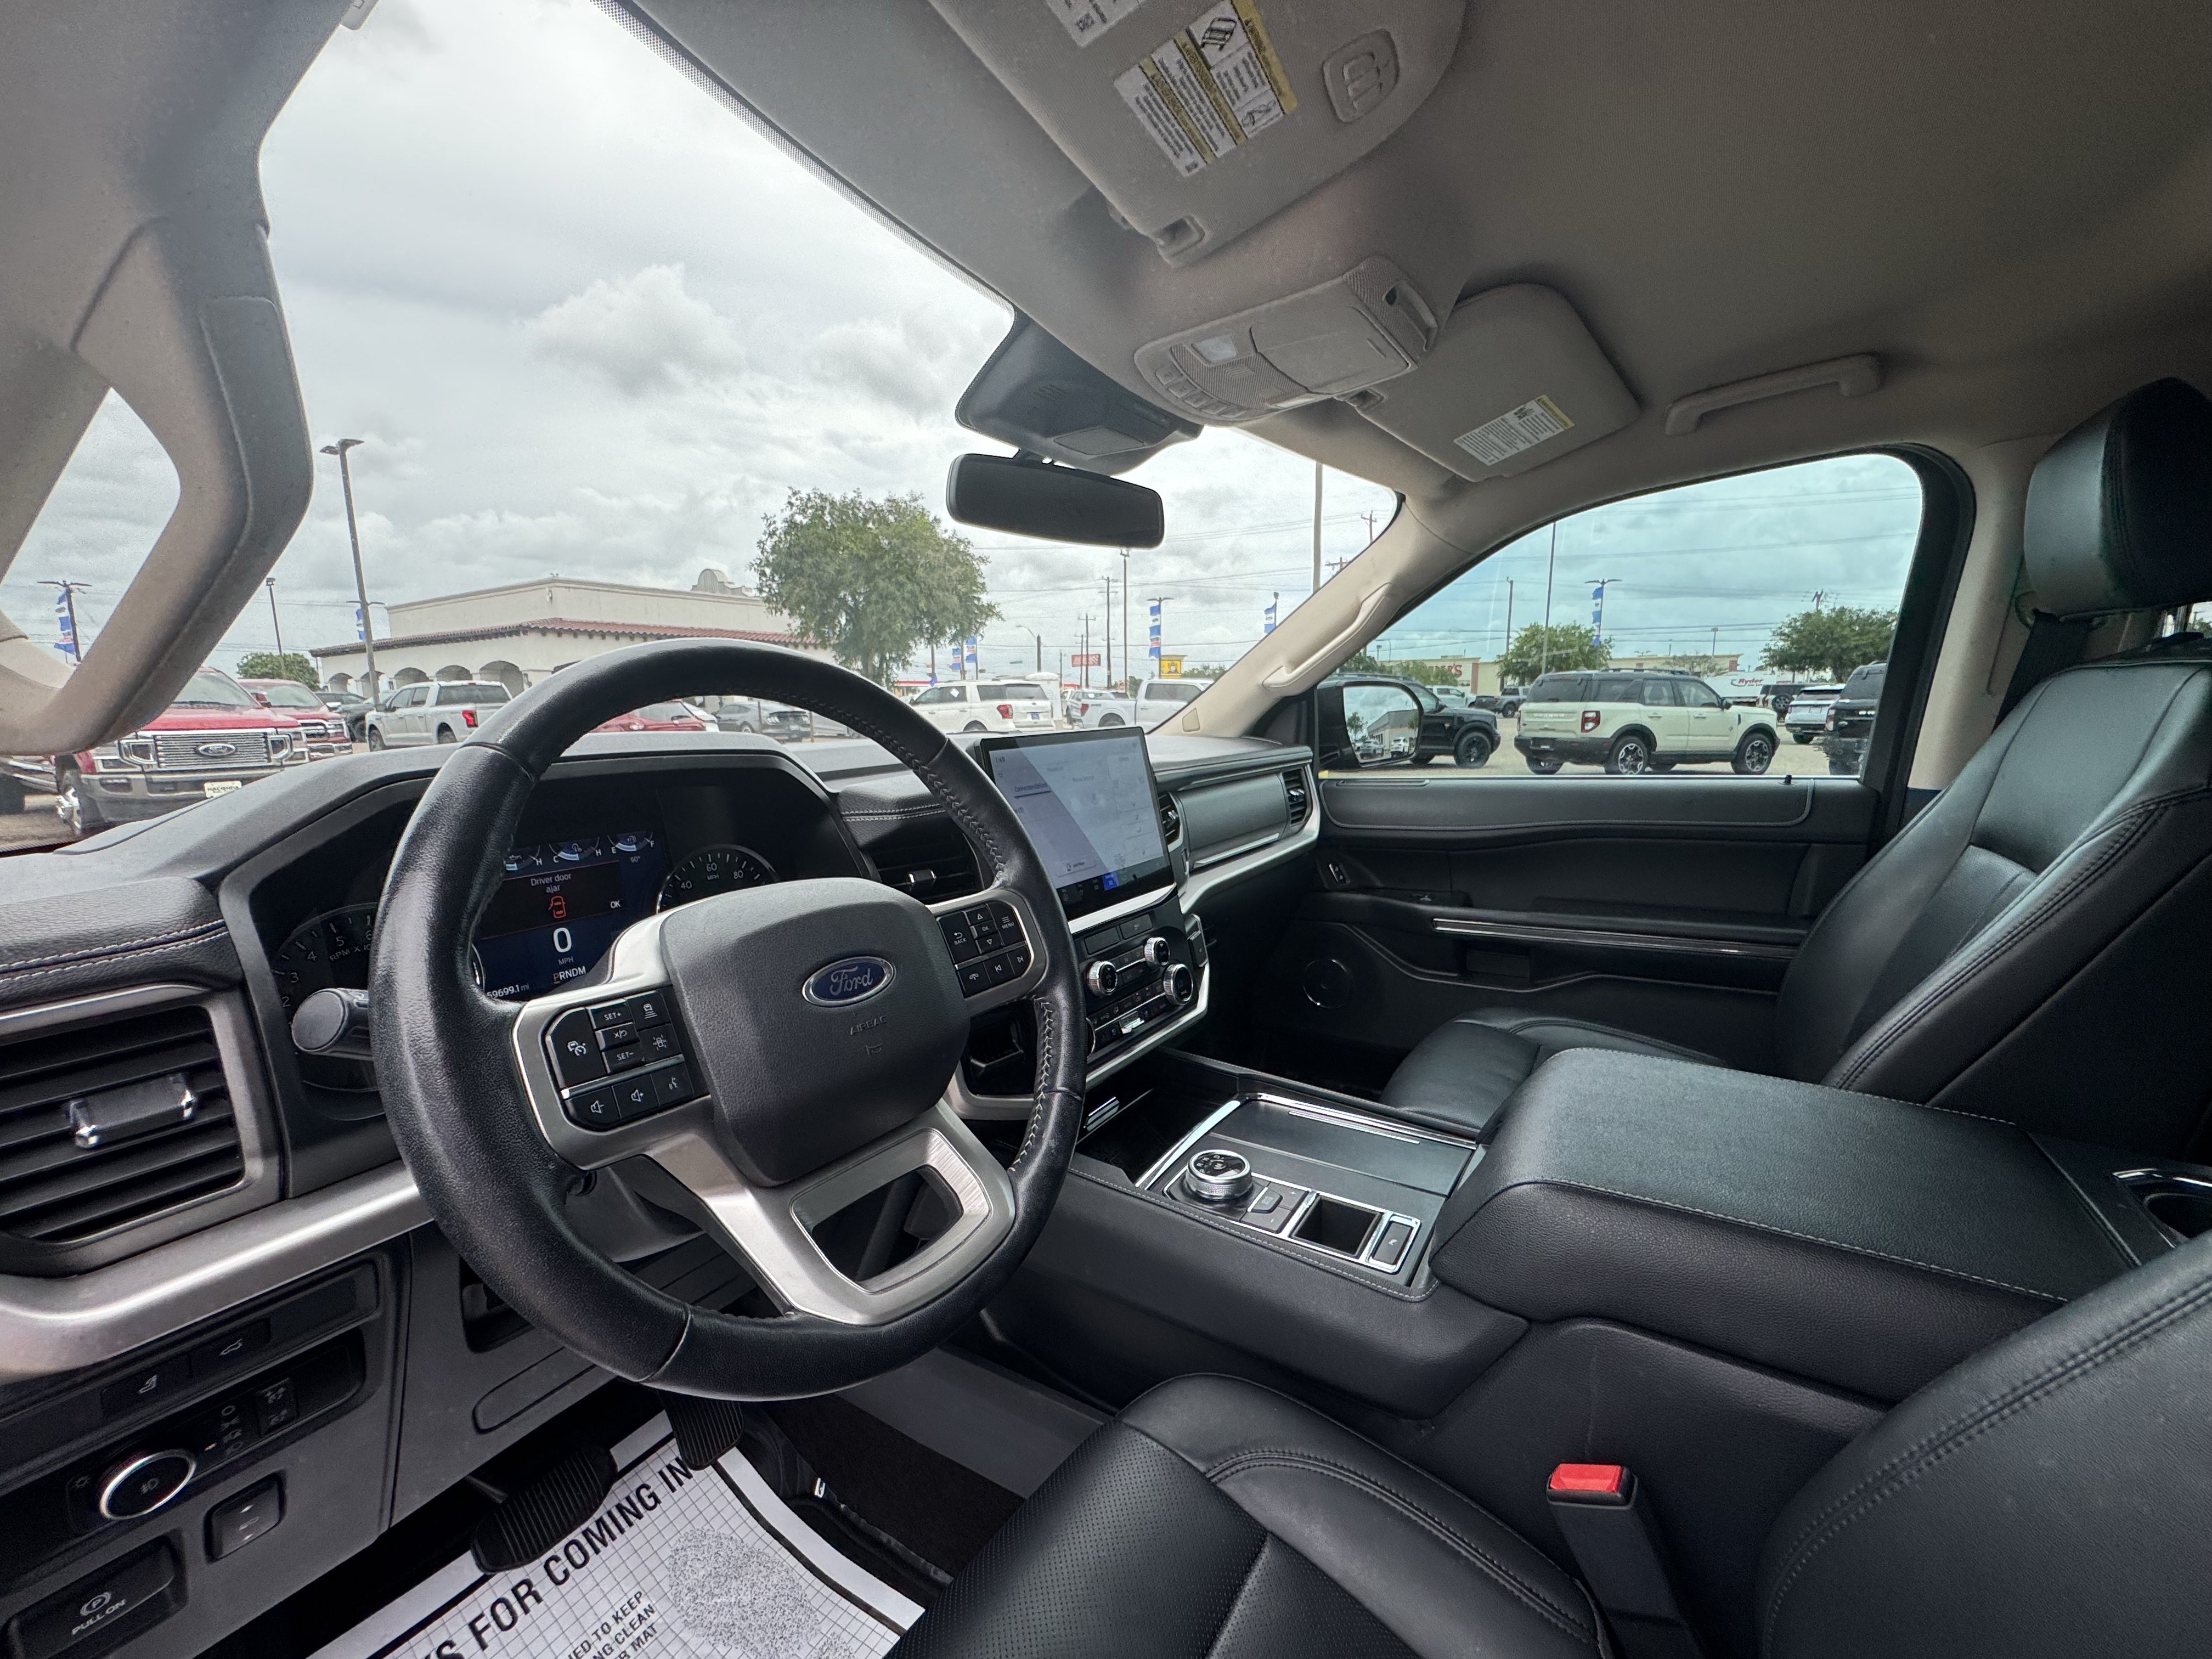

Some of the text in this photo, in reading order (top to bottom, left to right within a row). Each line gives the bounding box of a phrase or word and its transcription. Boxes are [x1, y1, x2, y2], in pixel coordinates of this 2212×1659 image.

[706, 862, 718, 872] 60
[531, 873, 572, 887] Driver door
[733, 870, 744, 879] 80
[546, 884, 561, 893] ajar
[681, 880, 692, 890] 40
[610, 900, 622, 910] OK
[335, 935, 345, 947] 5
[552, 927, 572, 953] 0
[307, 951, 318, 962] 4
[329, 948, 351, 962] RPM
[558, 956, 574, 966] MPH
[290, 972, 300, 983] 3
[830, 966, 874, 996] Ford
[469, 1579, 544, 1651] FOR
[543, 1483, 663, 1586] COMING
[658, 1457, 694, 1493] IN
[71, 1599, 126, 1635] PULL ON
[591, 1622, 611, 1641] TO
[612, 1591, 642, 1624] KEEP
[614, 1604, 655, 1645] CLEAN
[631, 1622, 657, 1652] MAT
